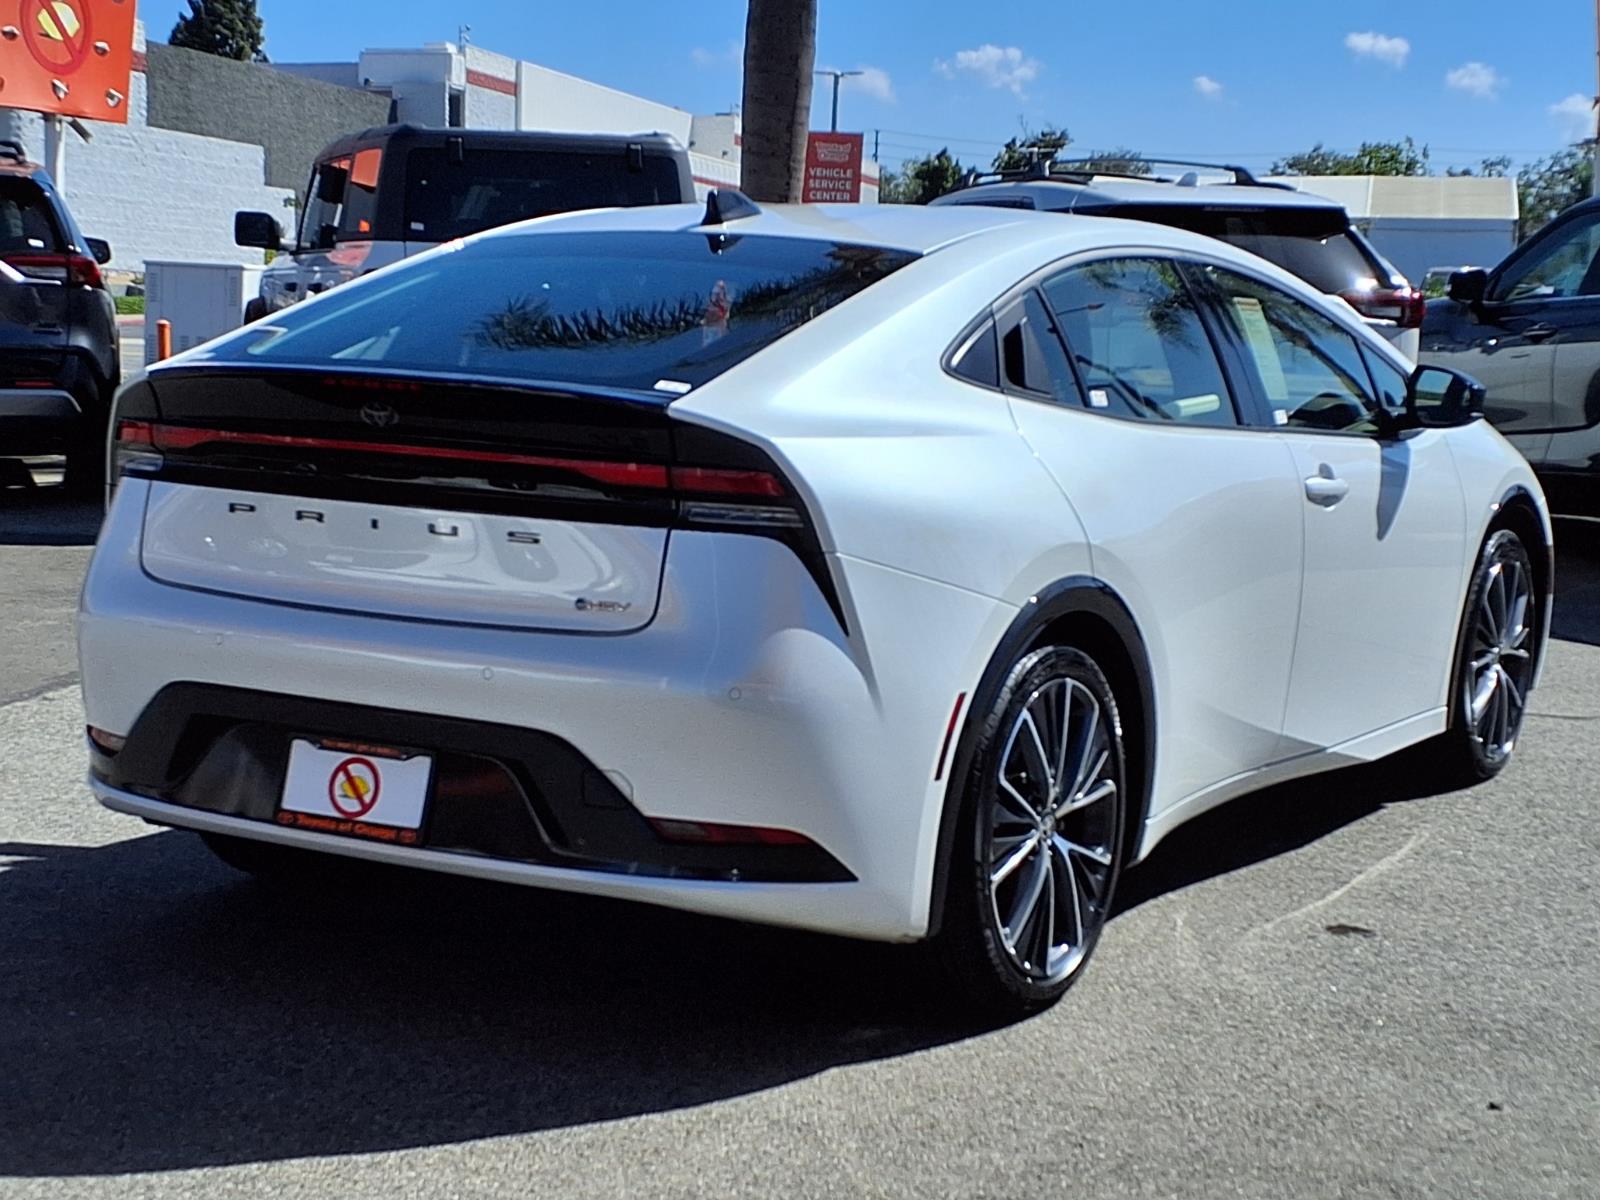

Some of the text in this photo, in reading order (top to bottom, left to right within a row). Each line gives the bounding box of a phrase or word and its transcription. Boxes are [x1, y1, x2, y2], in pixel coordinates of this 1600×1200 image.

[809, 167, 853, 178] VEHICLE
[809, 179, 852, 190] SERVICE
[809, 190, 850, 201] CENTER
[228, 502, 541, 544] PRIUS
